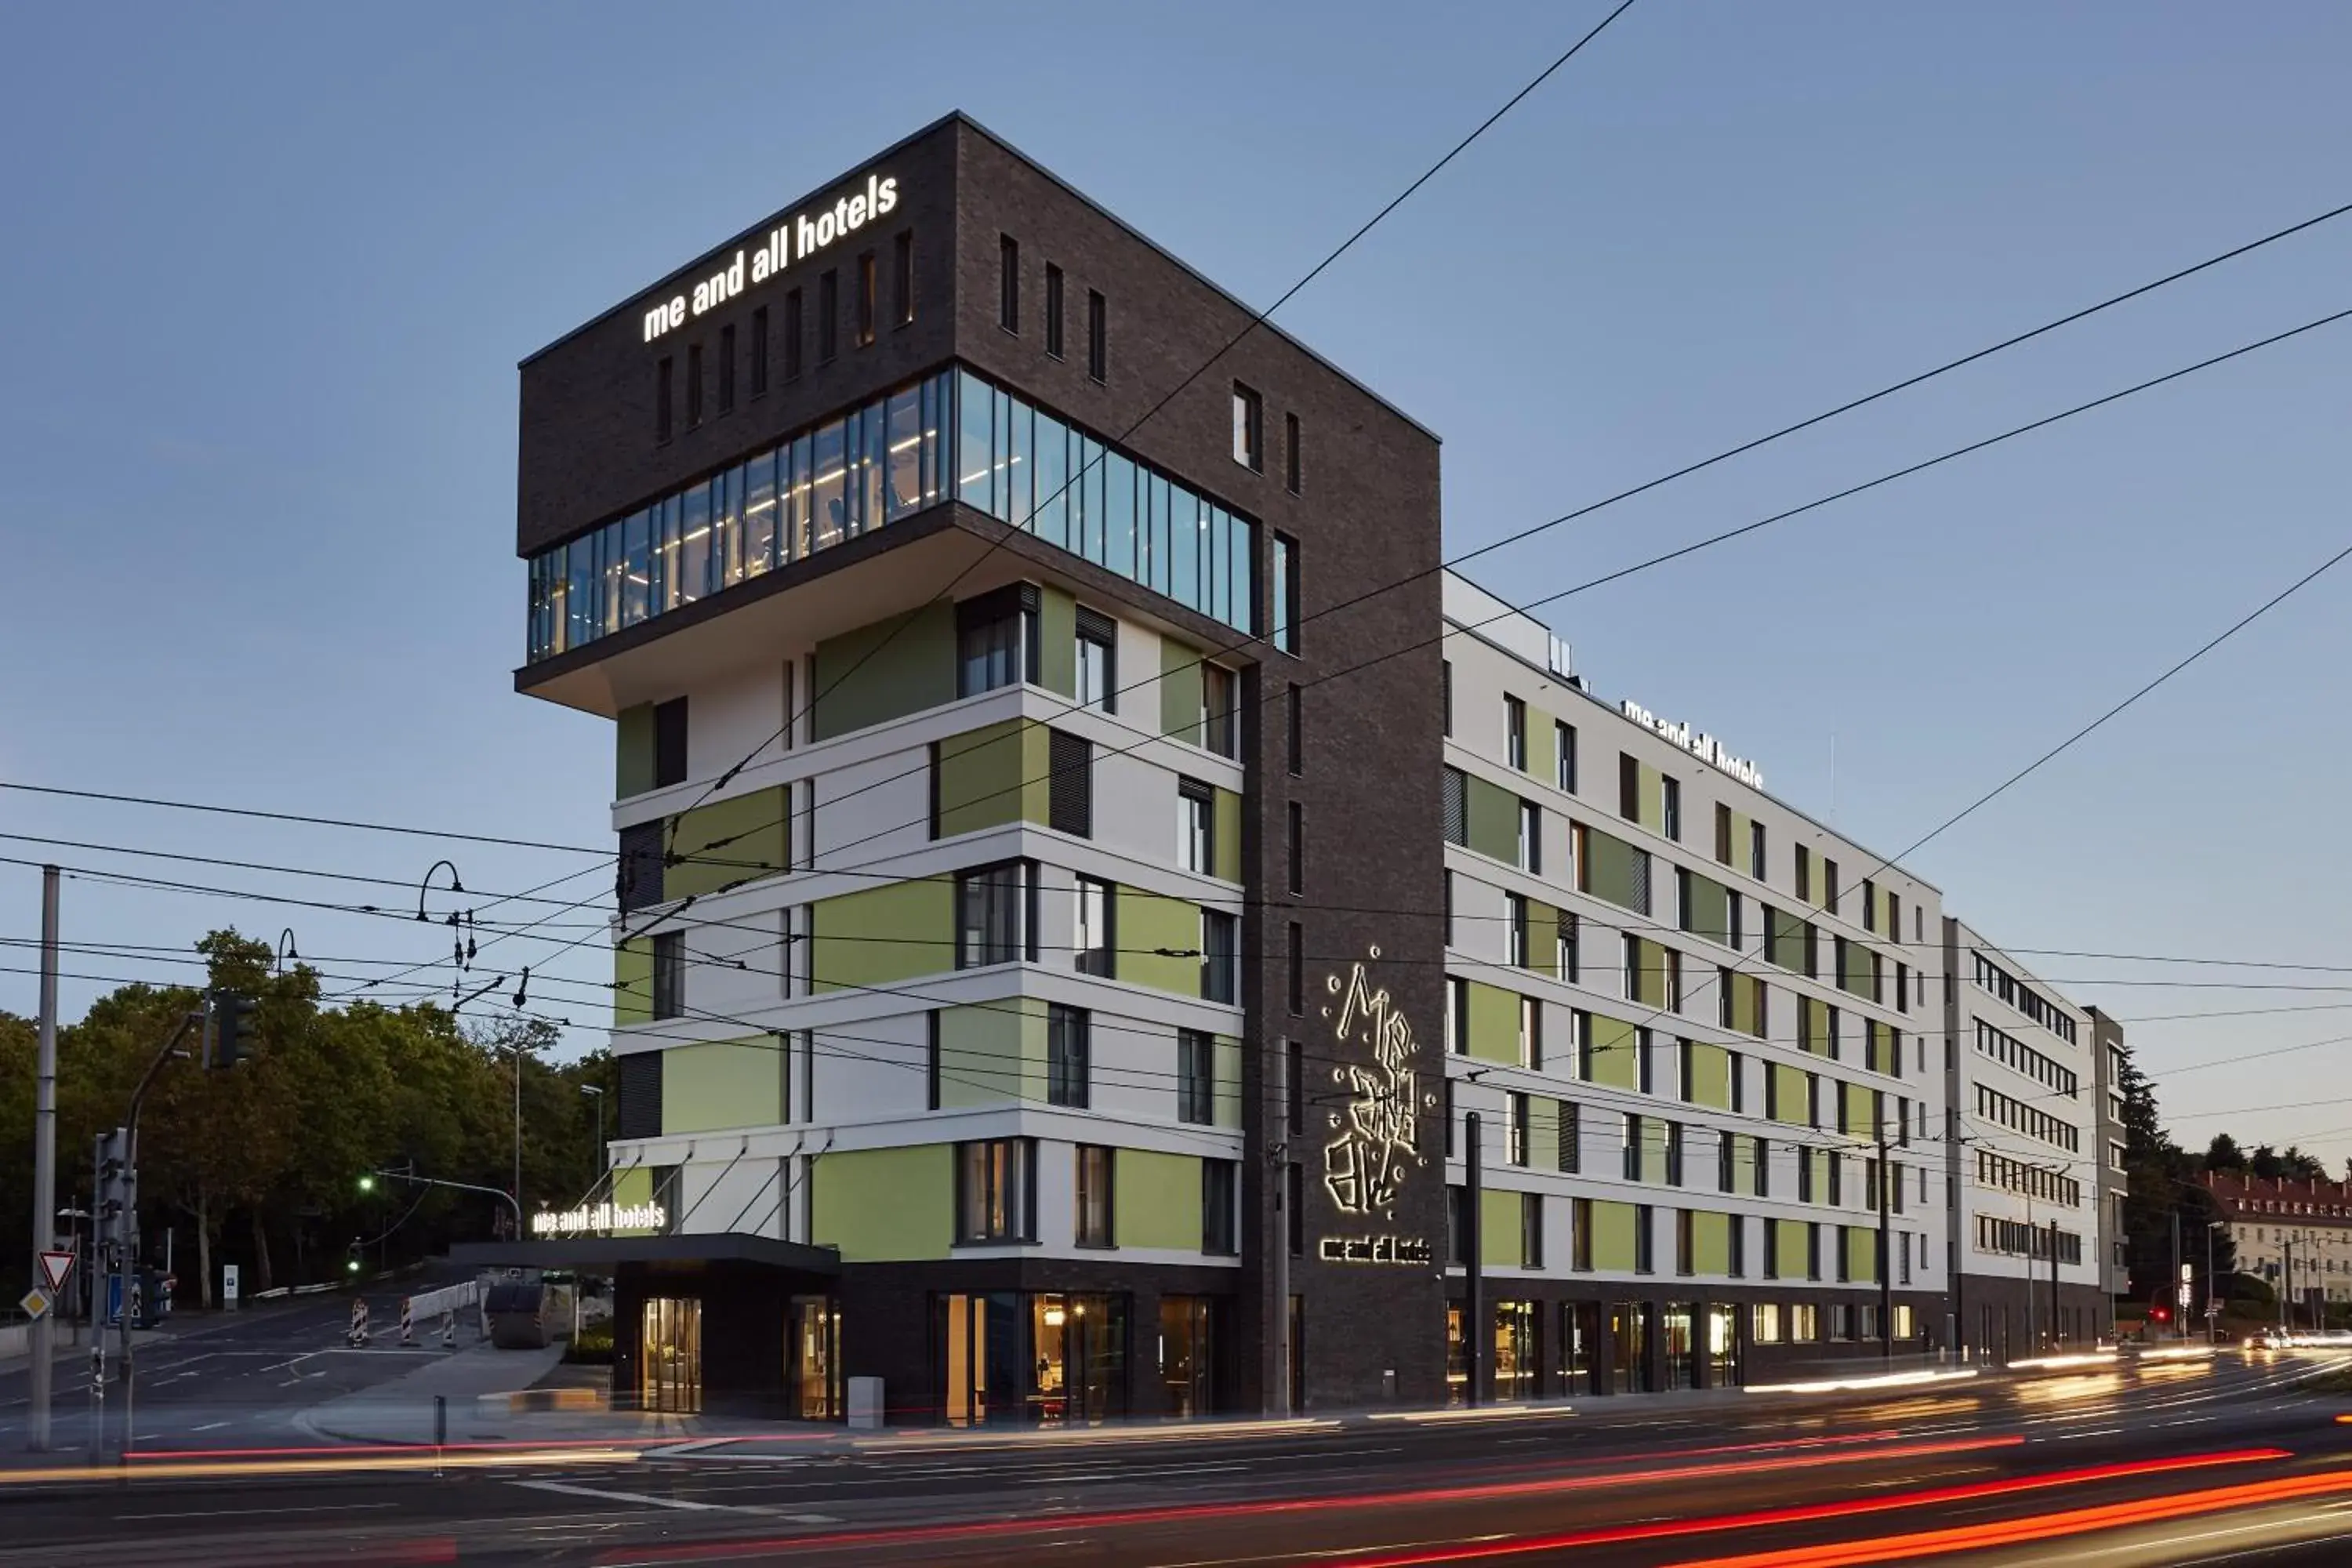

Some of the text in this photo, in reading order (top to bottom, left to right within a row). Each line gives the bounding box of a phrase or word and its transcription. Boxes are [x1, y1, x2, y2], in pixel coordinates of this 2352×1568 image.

[644, 175, 898, 343] me and all hotels
[533, 1200, 665, 1232] me and all hotels
